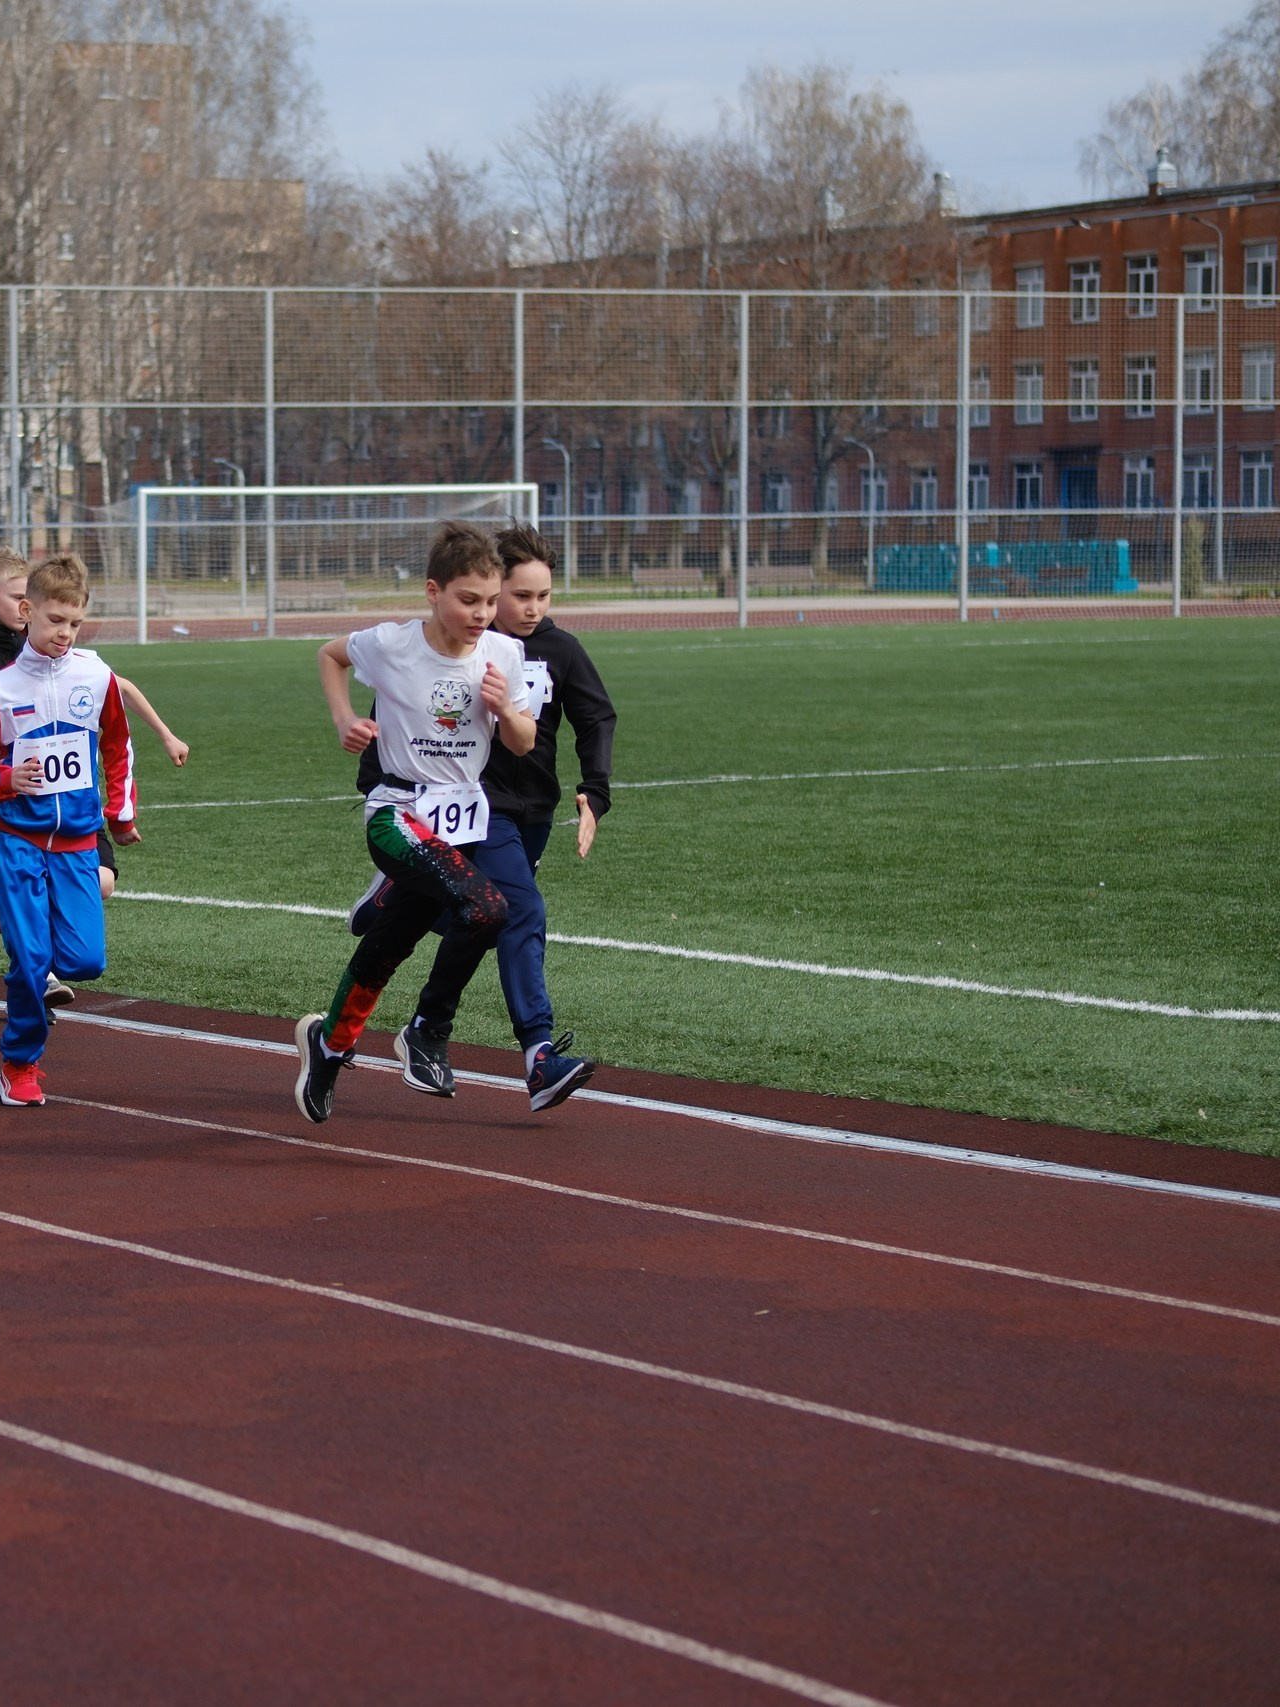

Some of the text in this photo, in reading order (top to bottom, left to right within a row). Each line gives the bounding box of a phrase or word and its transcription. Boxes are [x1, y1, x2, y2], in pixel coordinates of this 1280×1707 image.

[410, 737, 477, 748] ДЕТСКАЯ ЛИГА
[417, 749, 468, 759] ТРИАТЛОНА
[427, 801, 479, 835] 191
